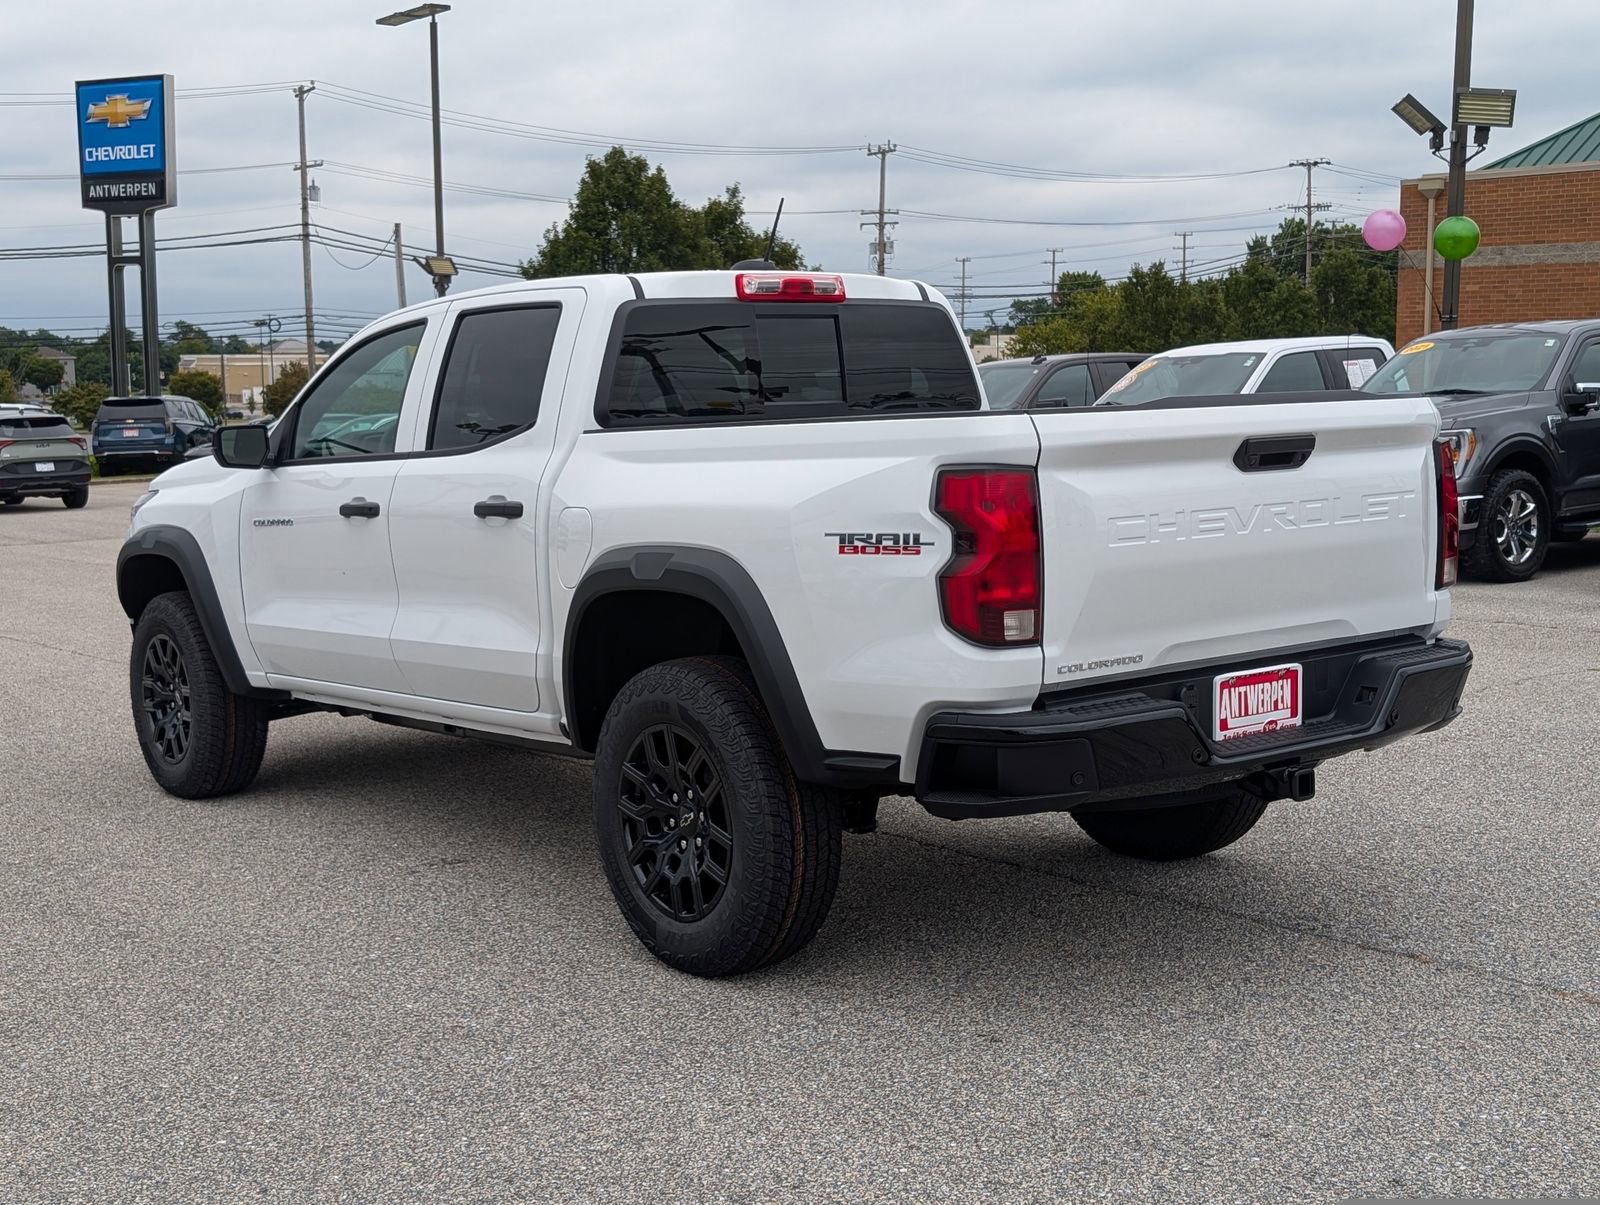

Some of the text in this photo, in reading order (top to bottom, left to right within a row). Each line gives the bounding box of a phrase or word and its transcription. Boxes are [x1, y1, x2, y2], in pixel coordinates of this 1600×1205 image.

[85, 144, 156, 162] CHEVROLET
[89, 182, 156, 198] ANTWERPEN
[1108, 490, 1415, 547] CHEVROLET
[824, 533, 935, 546] TRAIL
[838, 545, 921, 555] BOSS
[1057, 654, 1144, 674] COLORADO
[1220, 678, 1292, 724] ANTWERPEN
